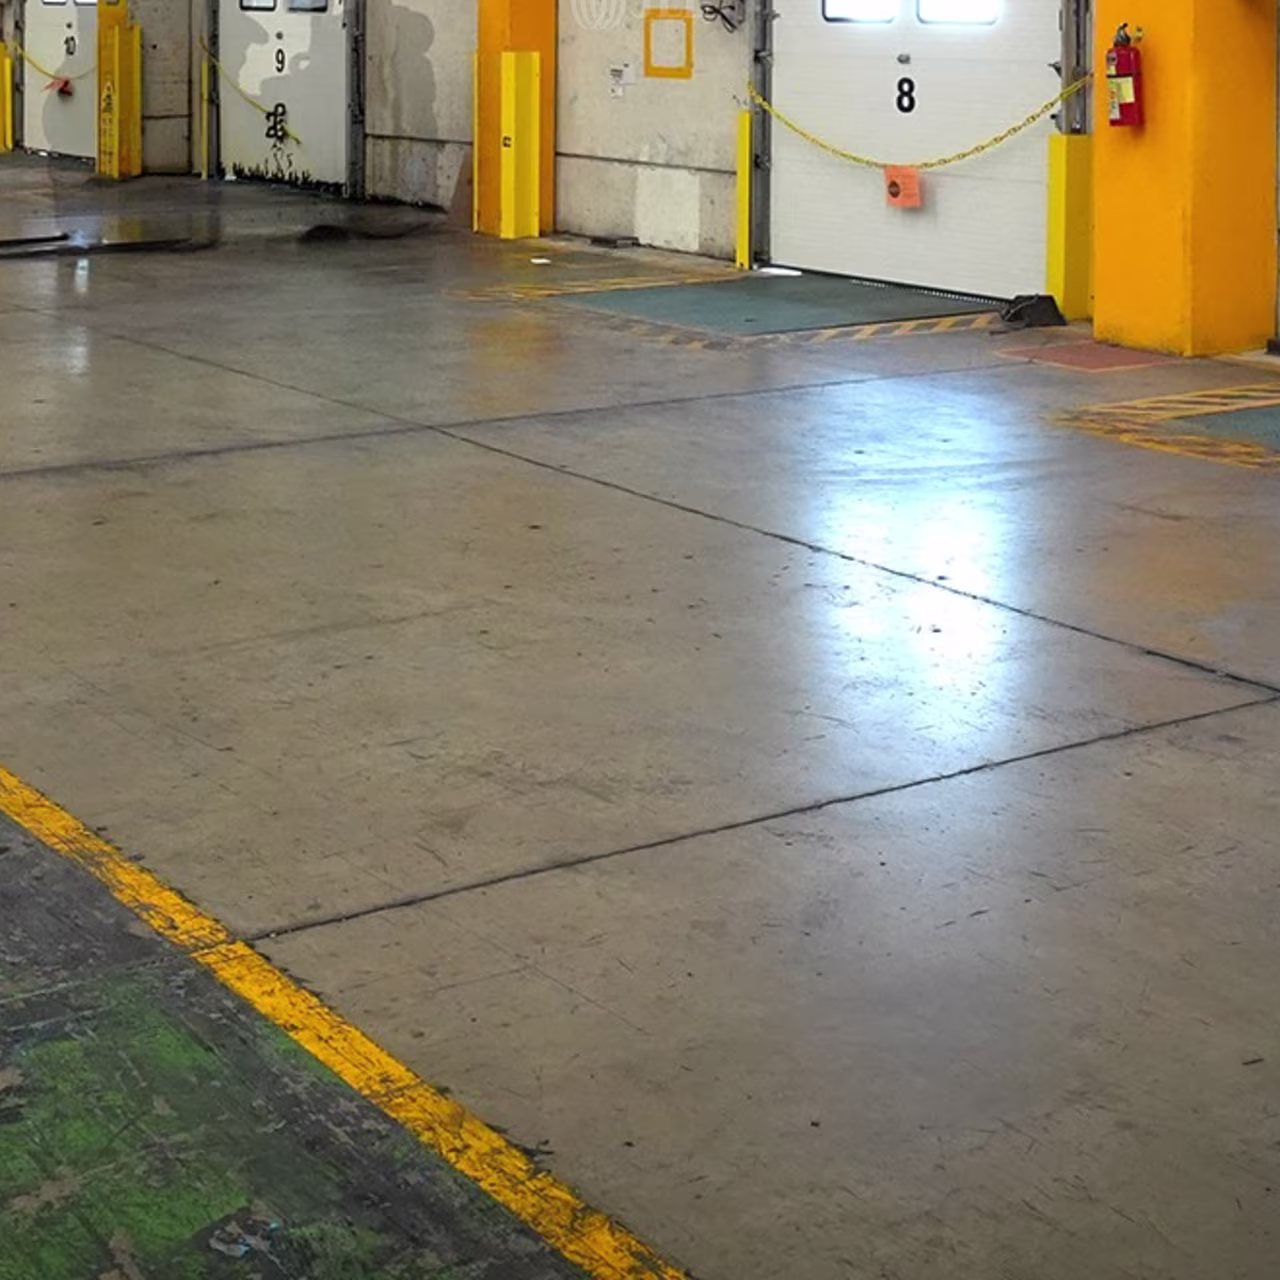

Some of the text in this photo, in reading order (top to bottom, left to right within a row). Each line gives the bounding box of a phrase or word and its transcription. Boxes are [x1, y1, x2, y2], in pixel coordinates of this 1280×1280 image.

[64, 36, 76, 55] 10
[275, 48, 285, 73] 9
[896, 77, 915, 113] 8
